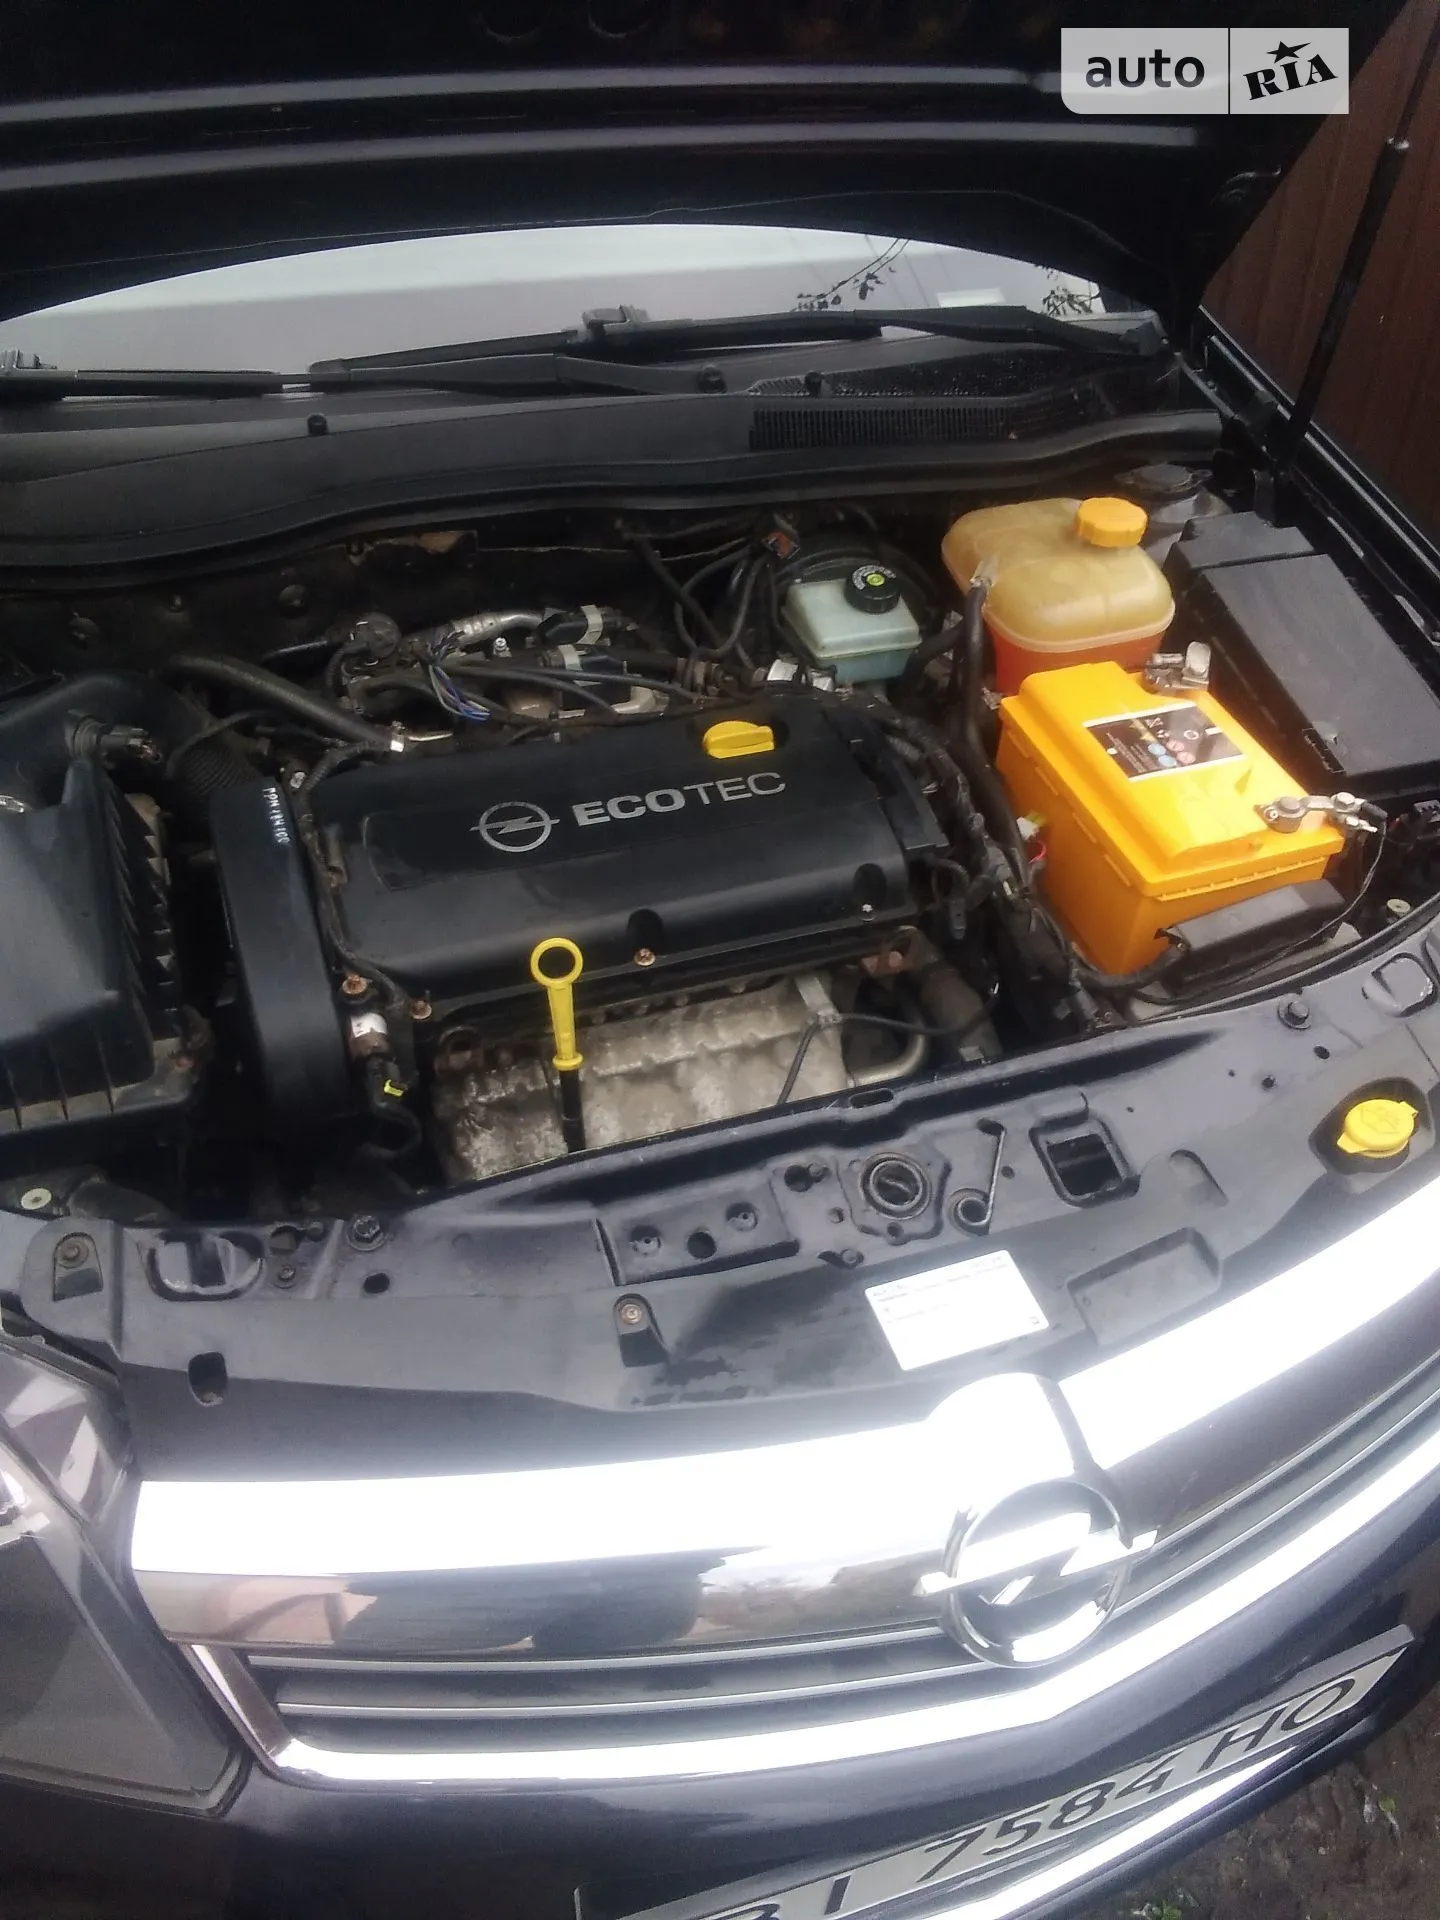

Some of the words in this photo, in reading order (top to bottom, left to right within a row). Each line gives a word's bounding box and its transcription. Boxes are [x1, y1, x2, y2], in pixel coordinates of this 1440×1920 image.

[571, 772, 786, 827] ECOTEC
[915, 1750, 1185, 1883] 7584
[1197, 1678, 1356, 1773] HO
